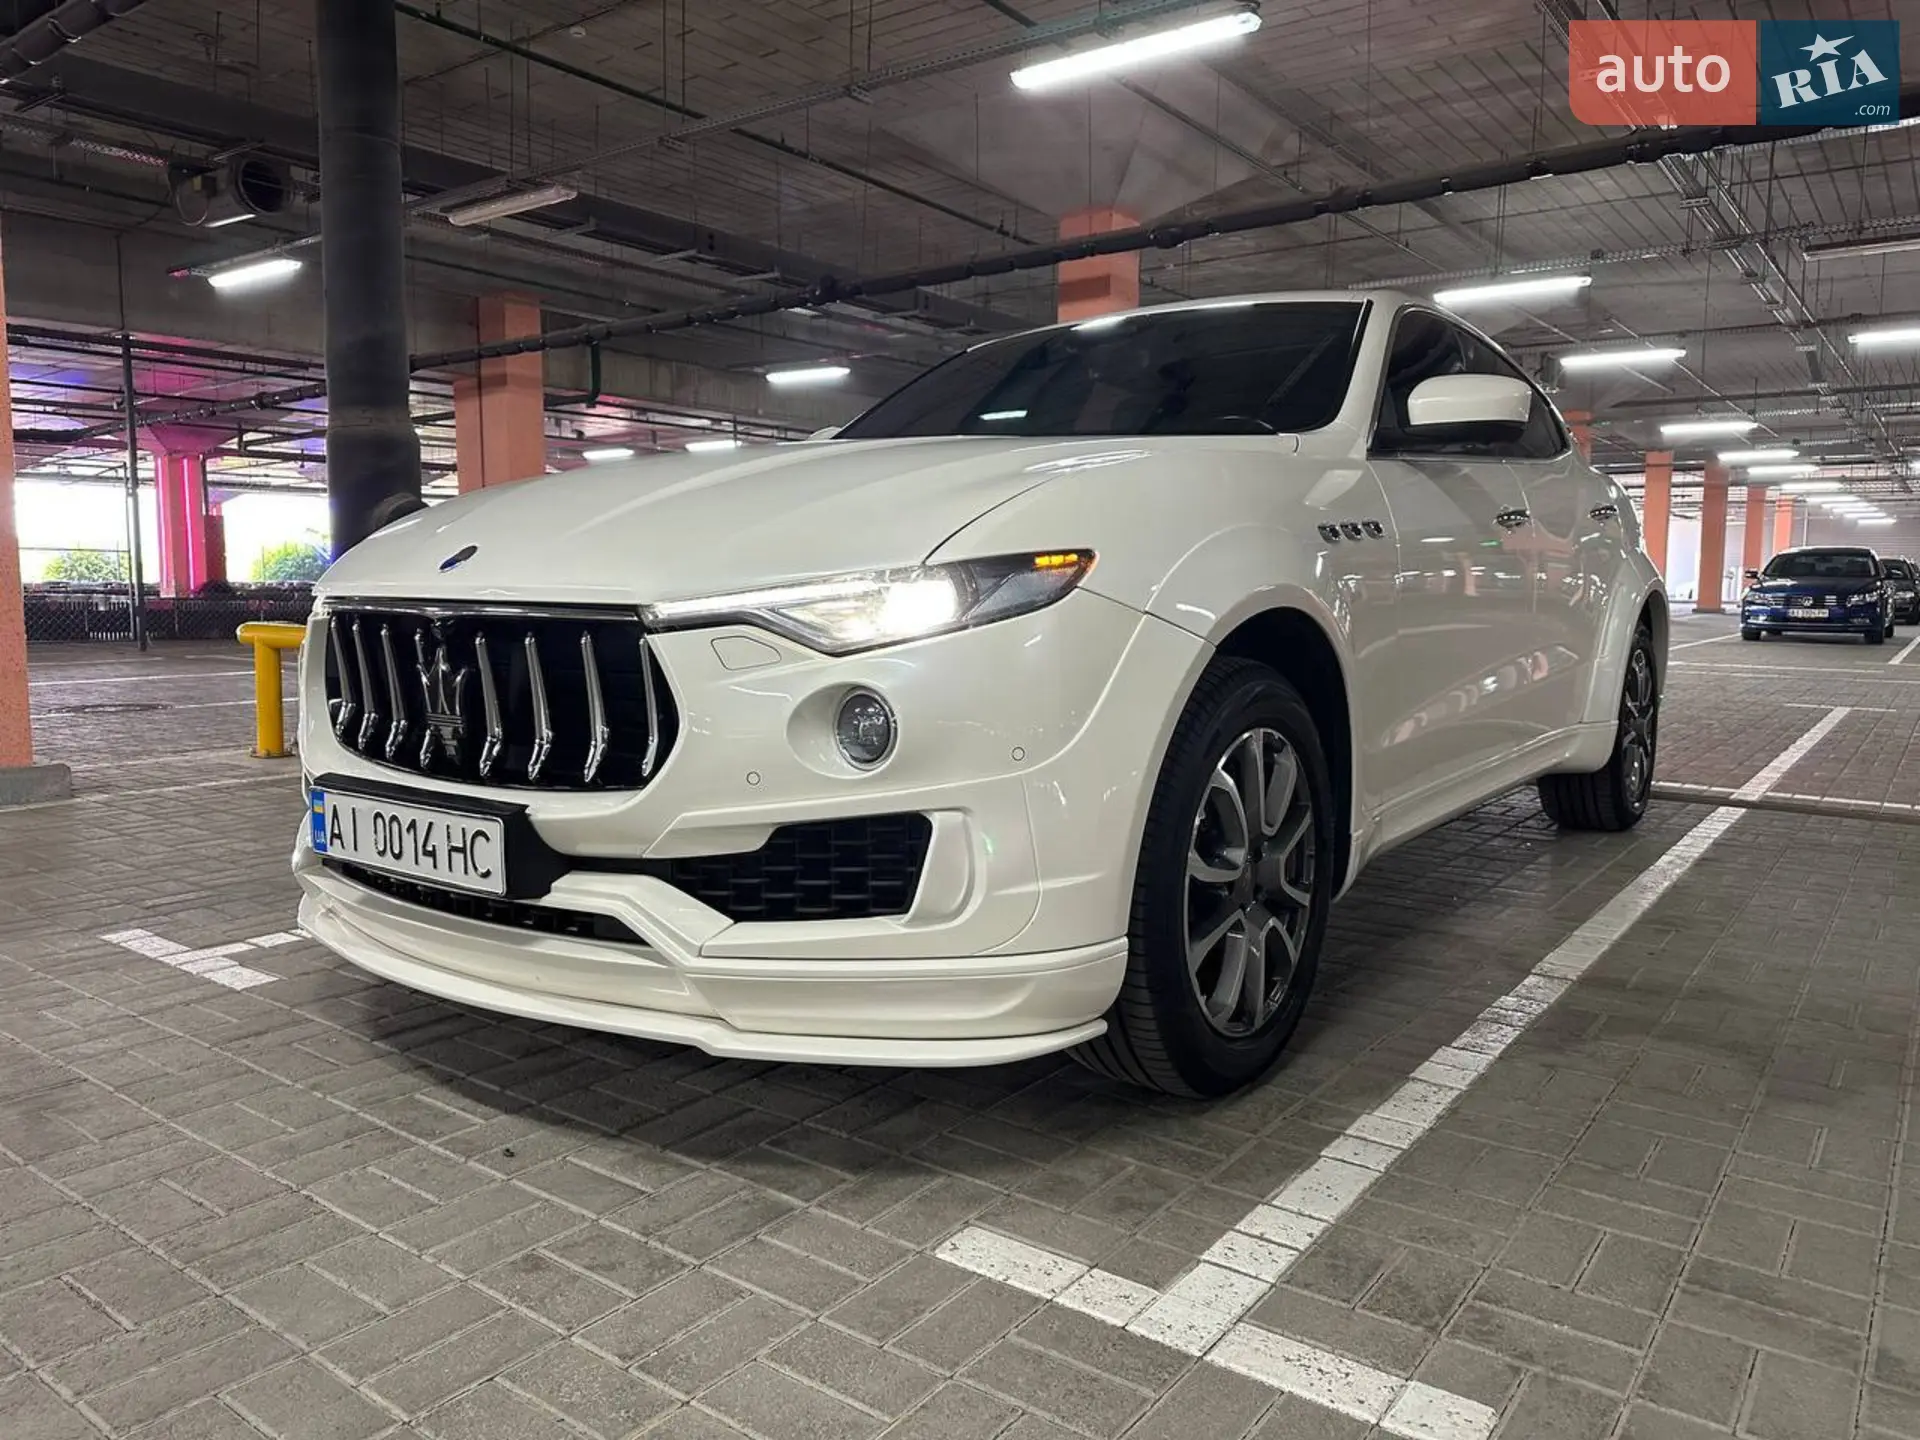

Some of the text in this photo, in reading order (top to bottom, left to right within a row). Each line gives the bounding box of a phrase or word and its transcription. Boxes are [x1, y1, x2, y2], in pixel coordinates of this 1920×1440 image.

[329, 804, 492, 879] AI 0014 HC
